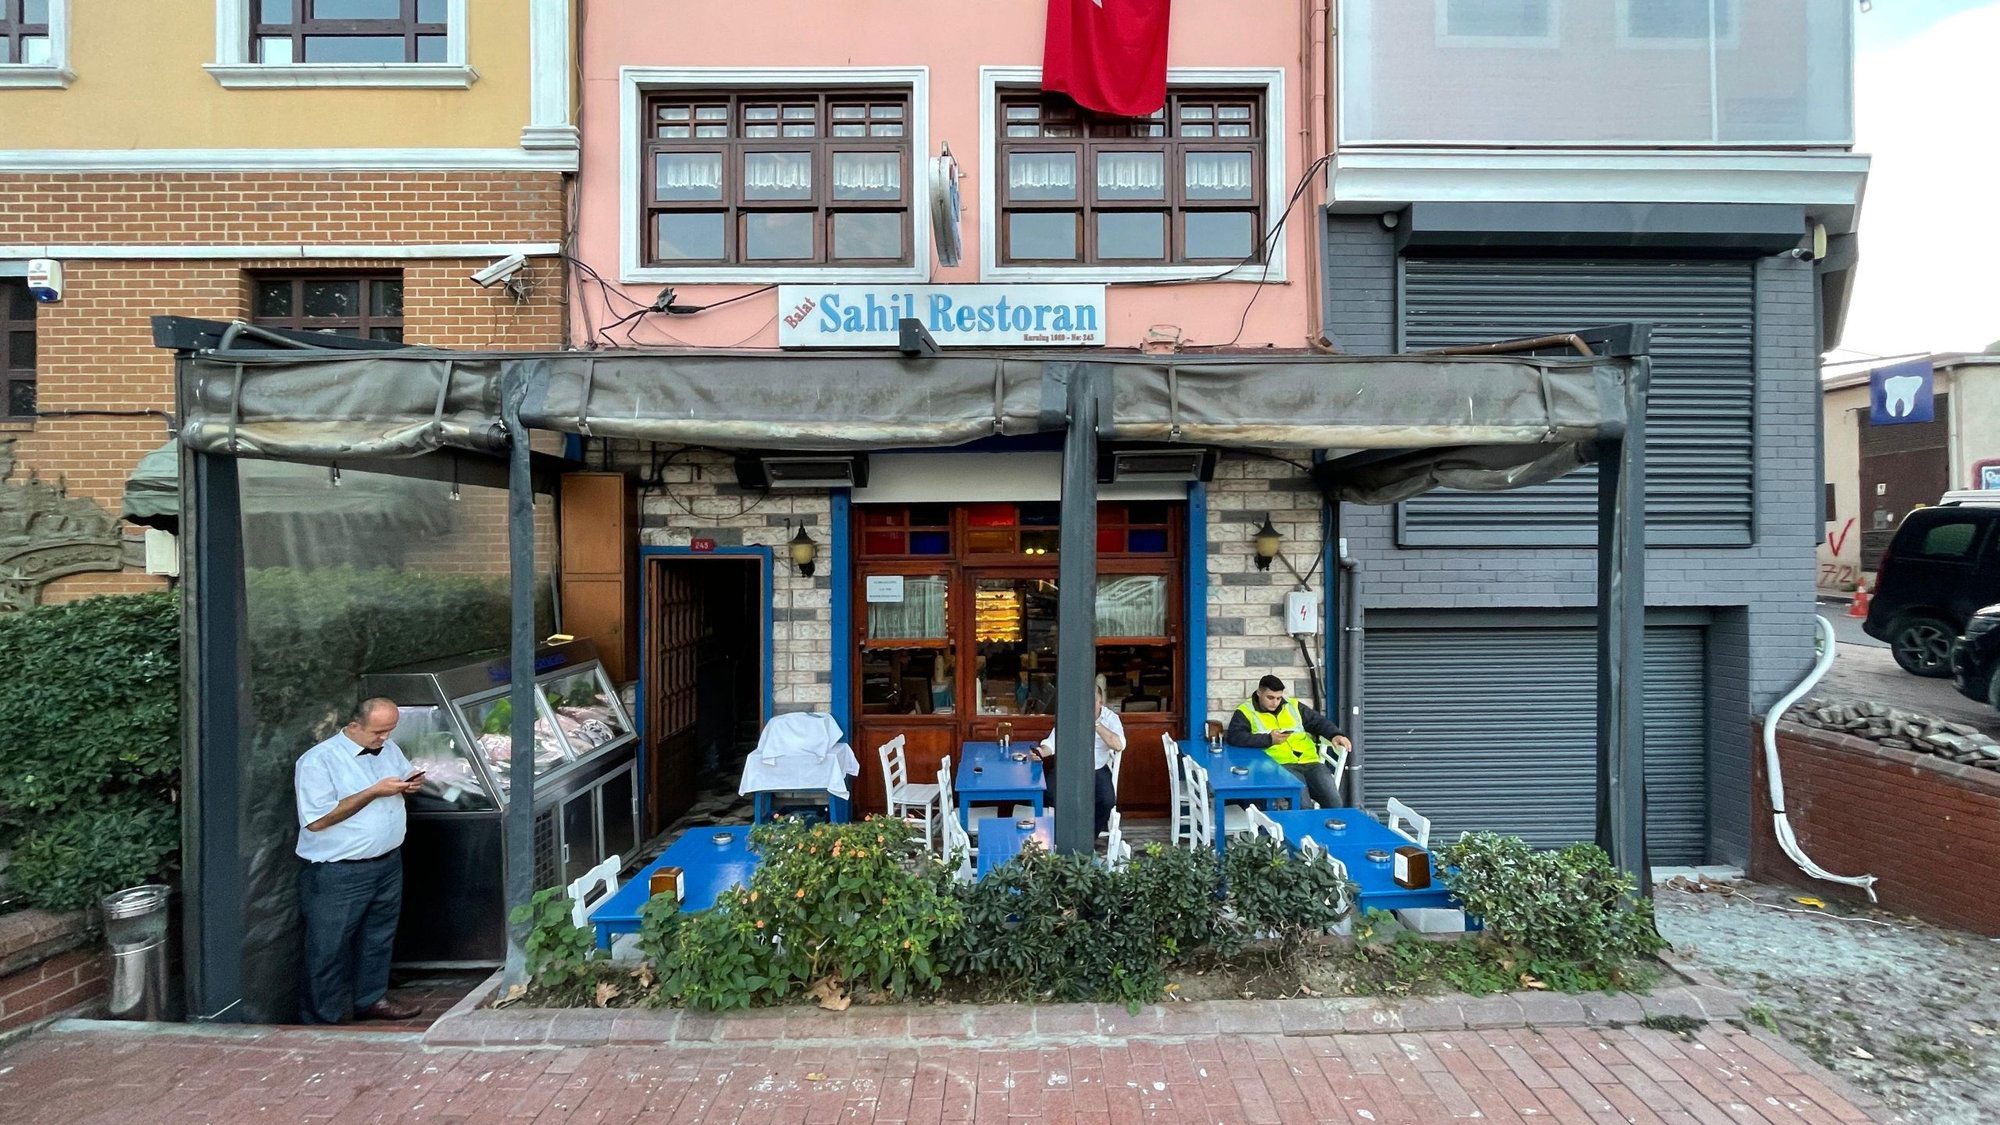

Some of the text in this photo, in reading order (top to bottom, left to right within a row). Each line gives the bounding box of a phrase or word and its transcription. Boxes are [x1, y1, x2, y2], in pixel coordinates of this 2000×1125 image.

[784, 297, 816, 328] Balat
[819, 293, 1098, 333] Sahil Restoran
